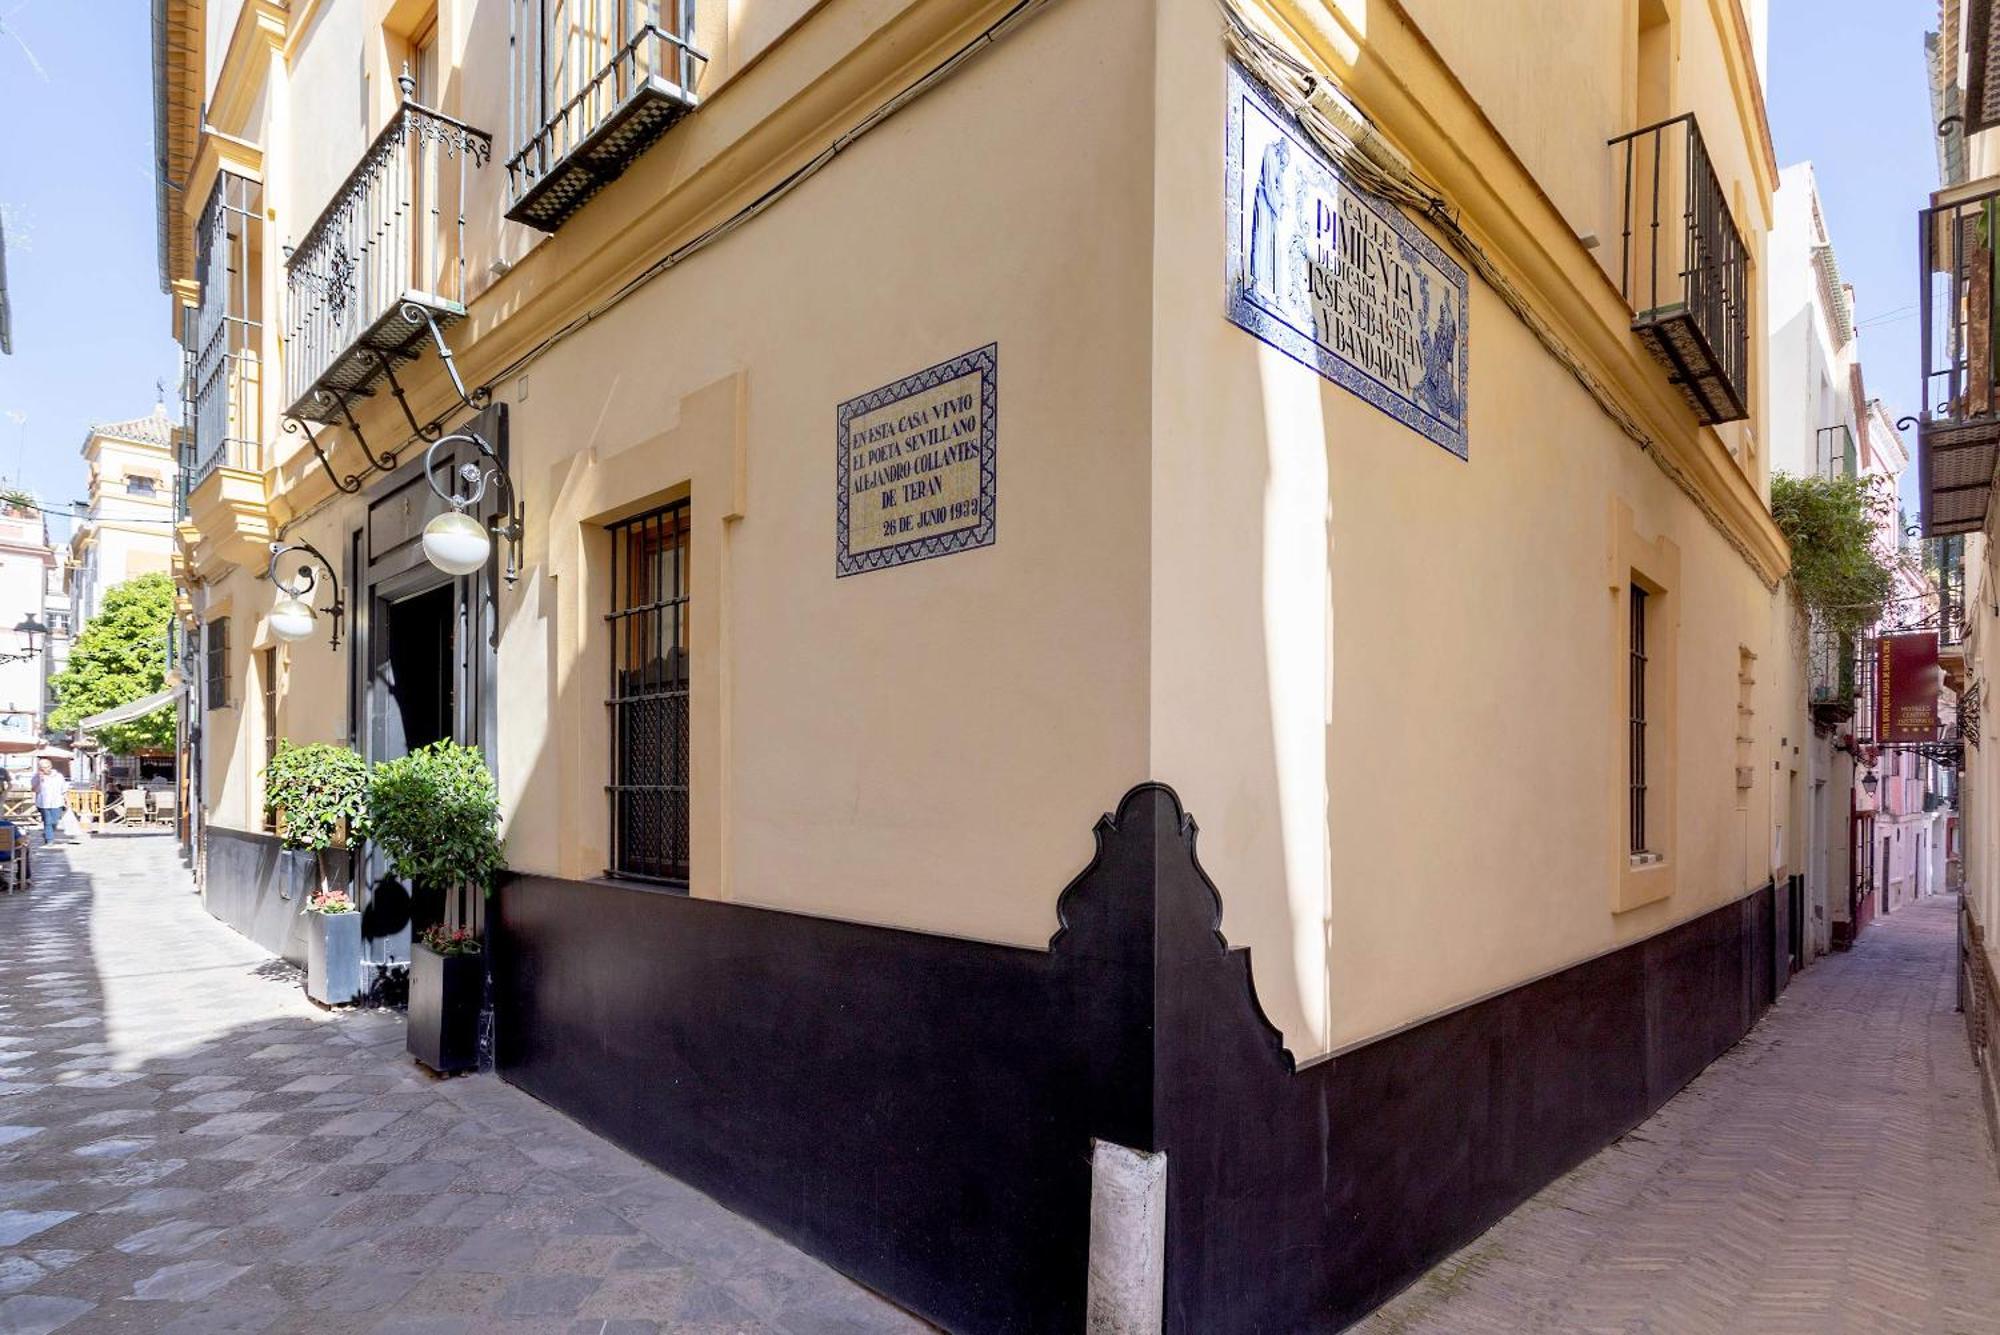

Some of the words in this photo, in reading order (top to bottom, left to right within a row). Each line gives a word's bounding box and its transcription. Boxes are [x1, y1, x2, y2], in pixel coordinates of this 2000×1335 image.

[1343, 197, 1393, 255] CALLE
[1316, 198, 1413, 312] PIMIENTA
[1318, 244, 1377, 305] DEDICADA
[1381, 293, 1389, 314] A
[1392, 301, 1413, 330] DON
[1322, 307, 1332, 344] Y
[1336, 316, 1410, 395] BANDARAN
[1348, 291, 1424, 371] SEBASTIAN
[853, 433, 867, 450] EN
[868, 422, 896, 442] ESTA
[899, 411, 929, 433] CASA
[932, 394, 973, 419] VIVIO
[853, 453, 866, 471] EL
[868, 442, 901, 466] POETA
[905, 415, 976, 452] SEVILLANO
[854, 460, 911, 494] ALEJANDRO
[914, 438, 980, 475] COLLANTES
[881, 489, 897, 509] DE
[903, 475, 943, 503] TERAN
[883, 520, 897, 537] 26
[899, 514, 915, 533] DE
[917, 506, 946, 528] JUNIO
[950, 498, 979, 521] 1933
